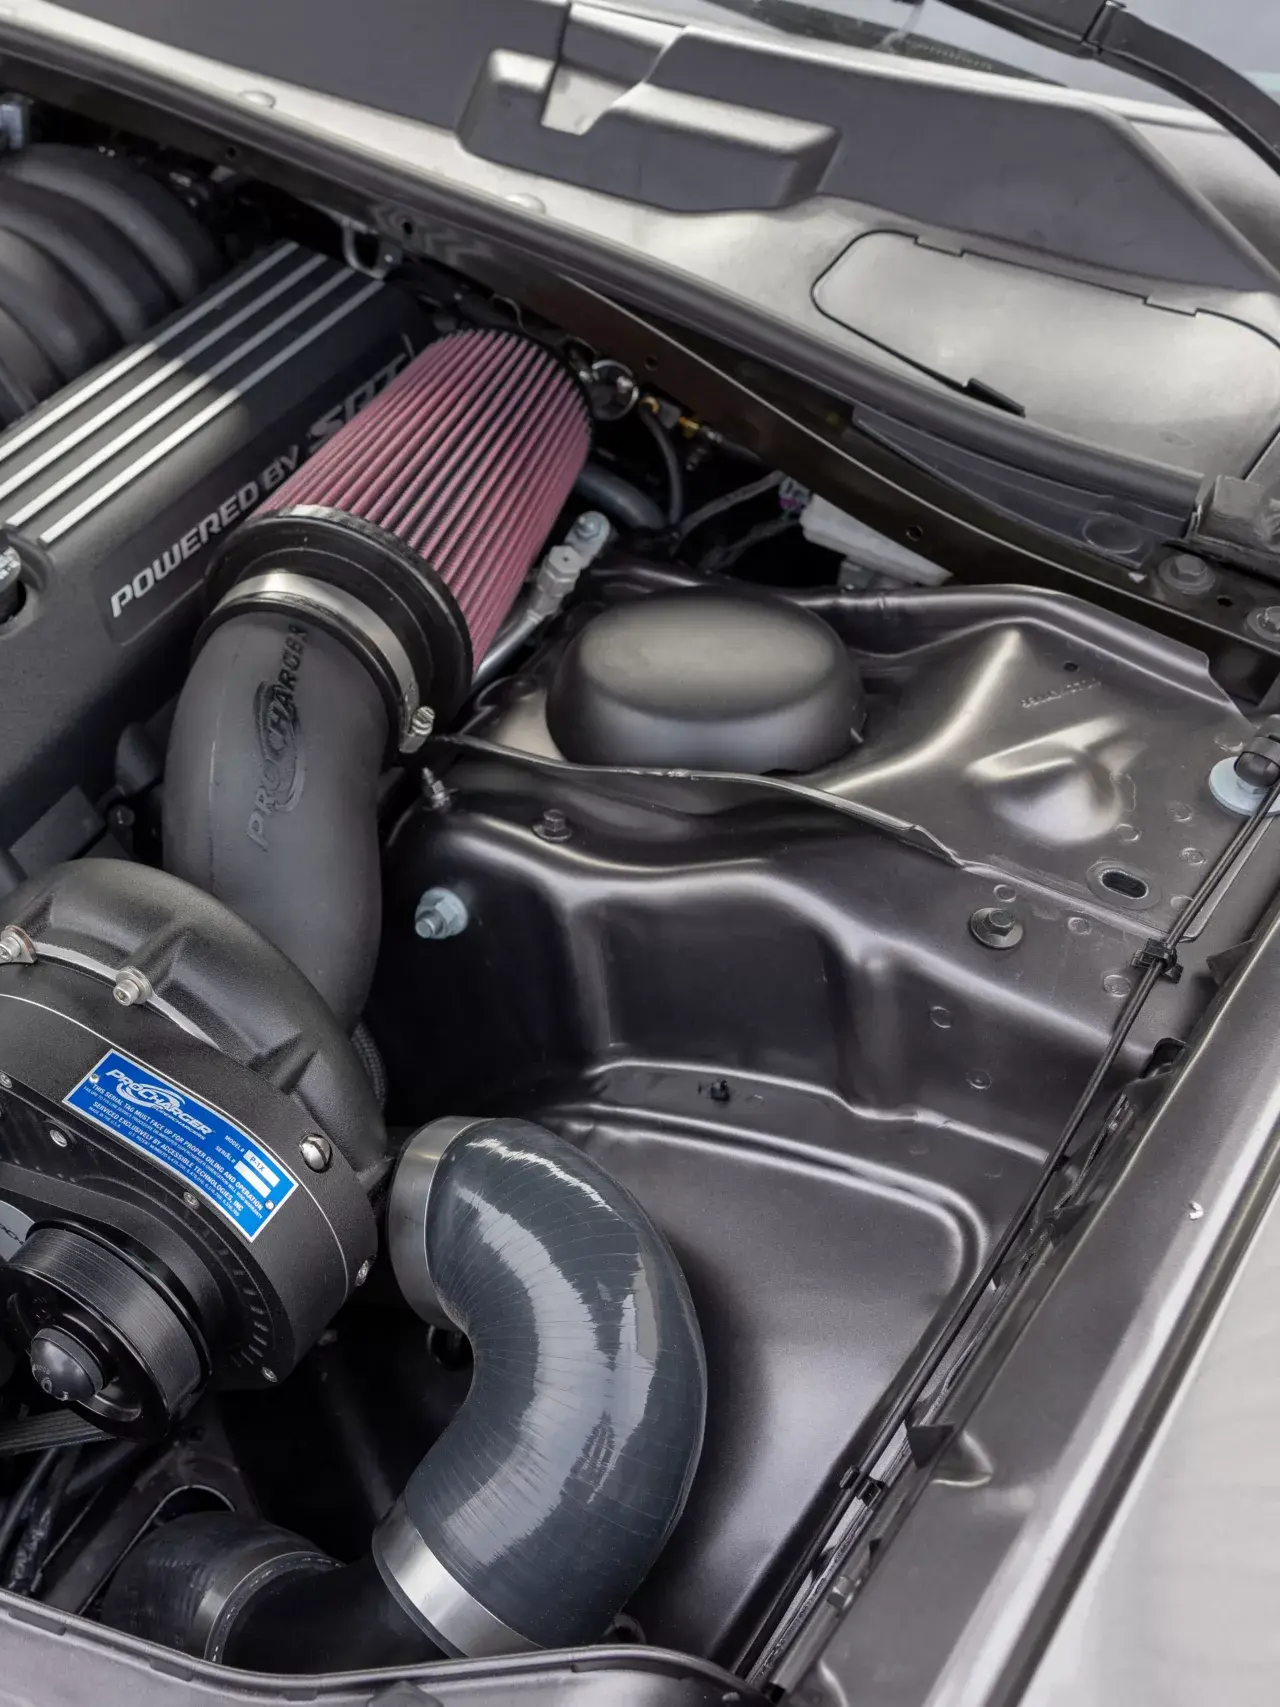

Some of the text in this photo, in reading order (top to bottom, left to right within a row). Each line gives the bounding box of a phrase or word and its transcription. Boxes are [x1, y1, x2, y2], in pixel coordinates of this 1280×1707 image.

[110, 483, 261, 618] POWERED
[261, 445, 300, 490] BY
[105, 1068, 214, 1135] PROCHARGER
[224, 1135, 242, 1152] MODEL
[92, 1083, 264, 1210] THIS SERIAL TAG MUST FACE UP FOR PROPER OILING AND OPERATION
[92, 1100, 244, 1212] SERVICED EXCLUSIVELY BY ACCESSIBLE TECHNOLOGIES, INC
[249, 1156, 266, 1172] P-1X
